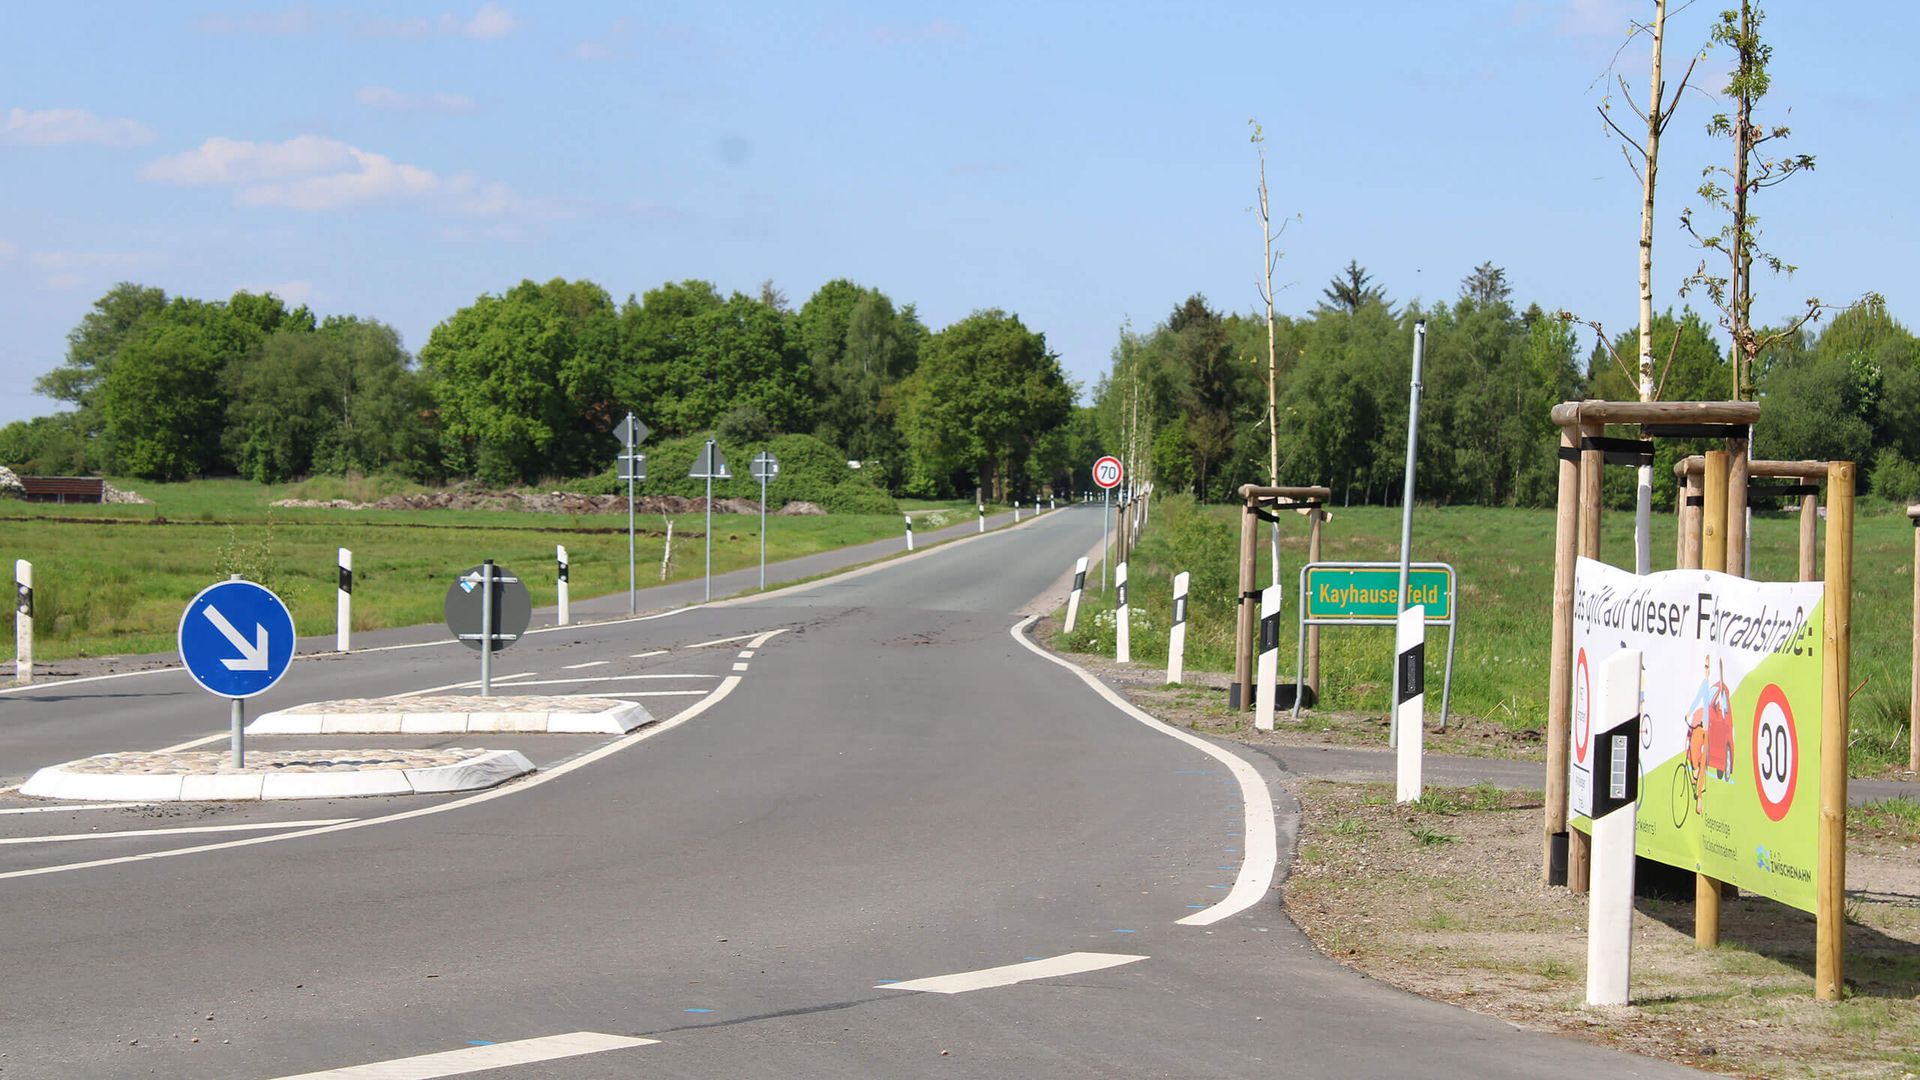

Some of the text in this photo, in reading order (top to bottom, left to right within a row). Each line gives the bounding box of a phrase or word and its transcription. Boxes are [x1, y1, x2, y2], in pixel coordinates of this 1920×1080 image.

[1100, 465, 1117, 480] 70
[1319, 583, 1438, 608] Kayhausefeld
[1631, 588, 1690, 638] dieser
[1761, 722, 1787, 783] 30
[1770, 860, 1812, 882] ZWISCHENAHN
